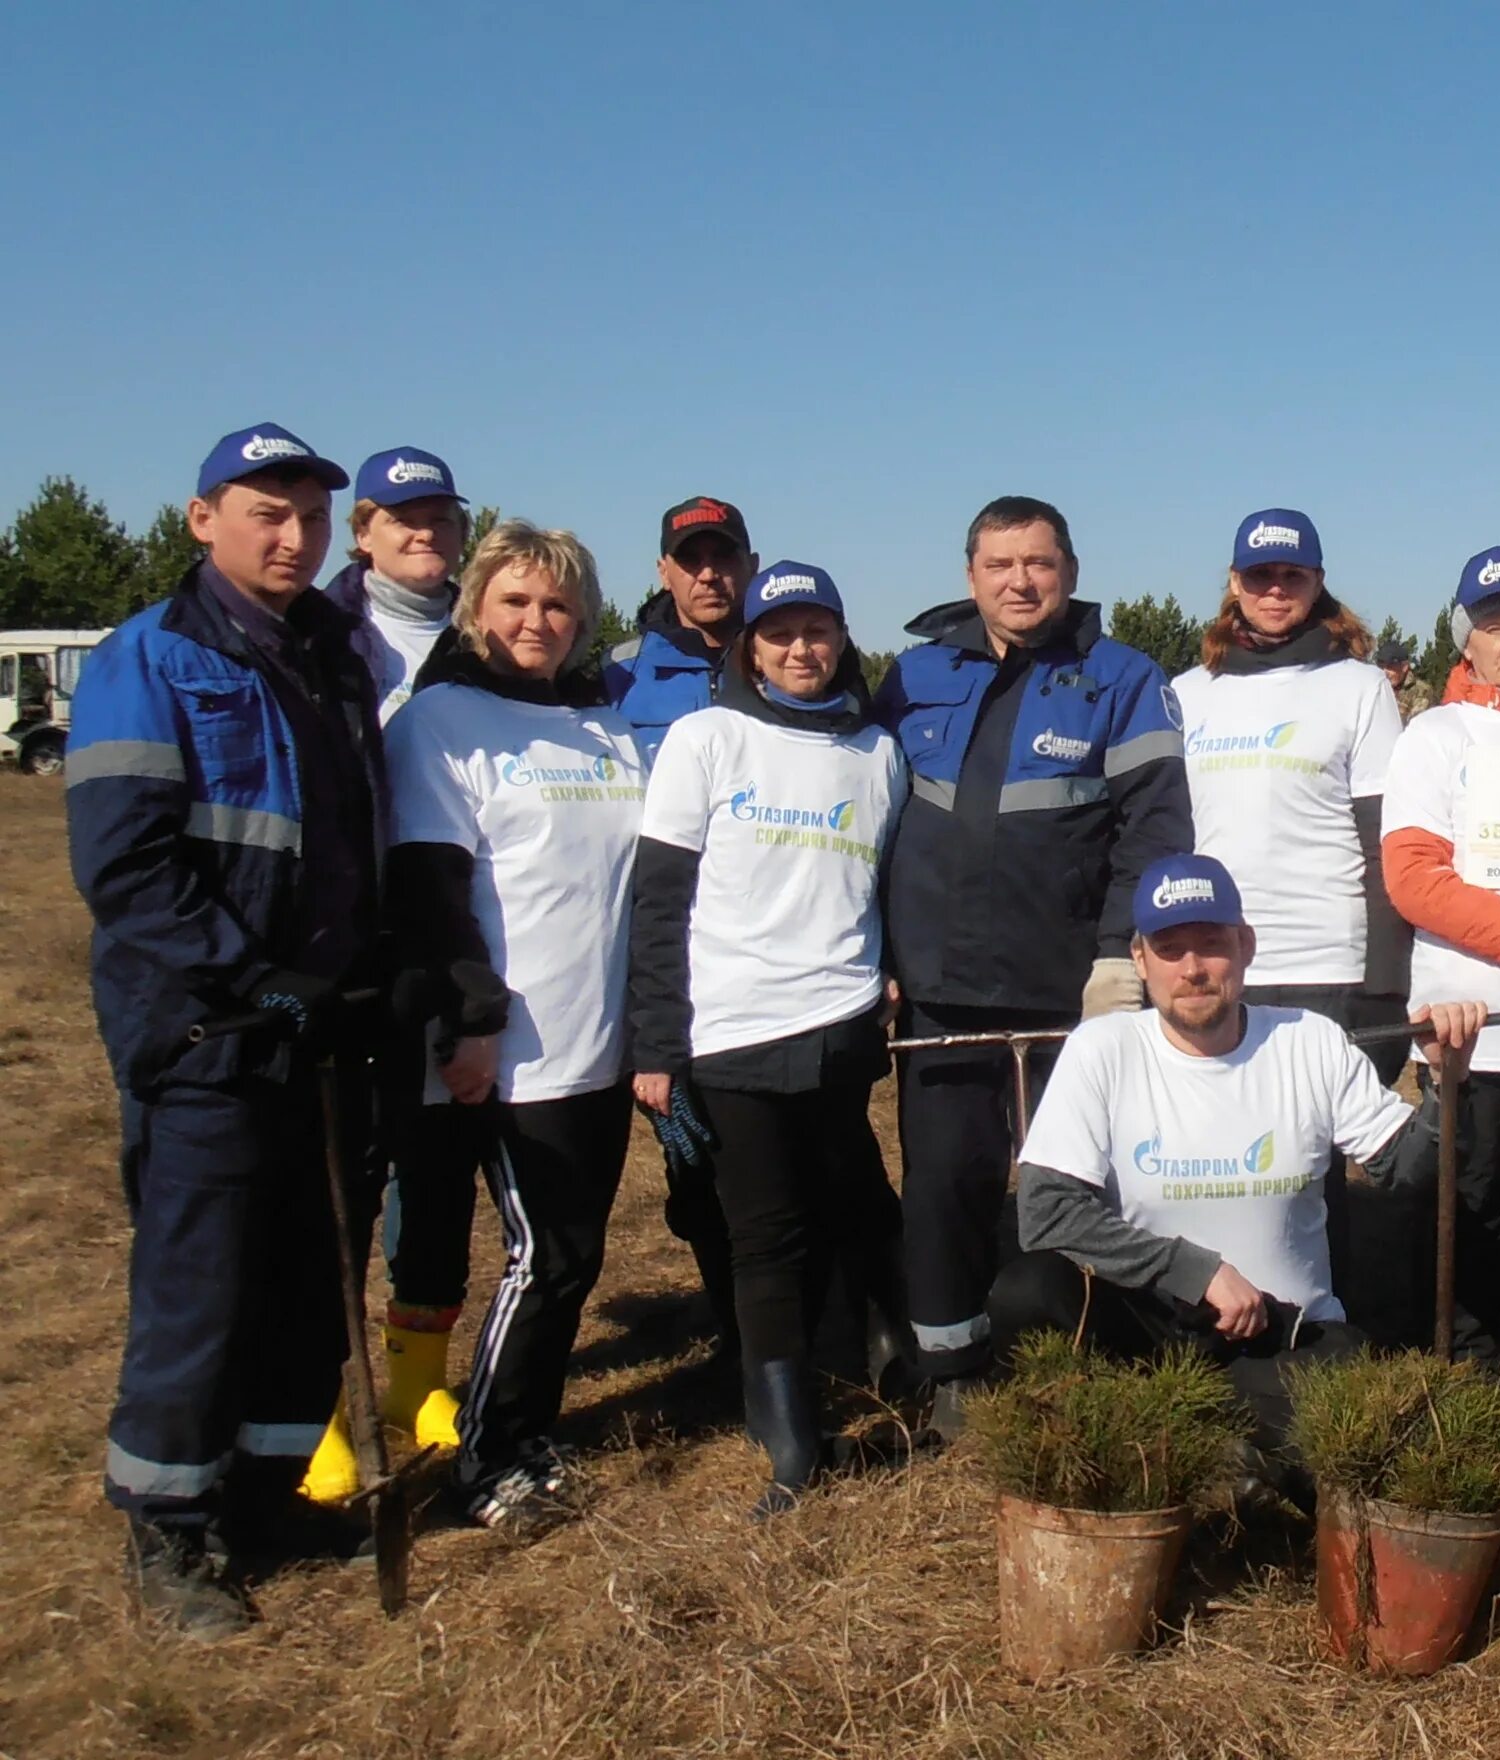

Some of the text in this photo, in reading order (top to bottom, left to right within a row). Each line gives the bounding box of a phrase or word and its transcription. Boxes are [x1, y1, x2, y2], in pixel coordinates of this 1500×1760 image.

[757, 806, 824, 828] ГАЗПРОМ
[832, 836, 879, 865] ПРИРОД
[1162, 1158, 1239, 1178] ГАЗПРОМ
[1162, 1181, 1247, 1201] СОХРАНЯЯ
